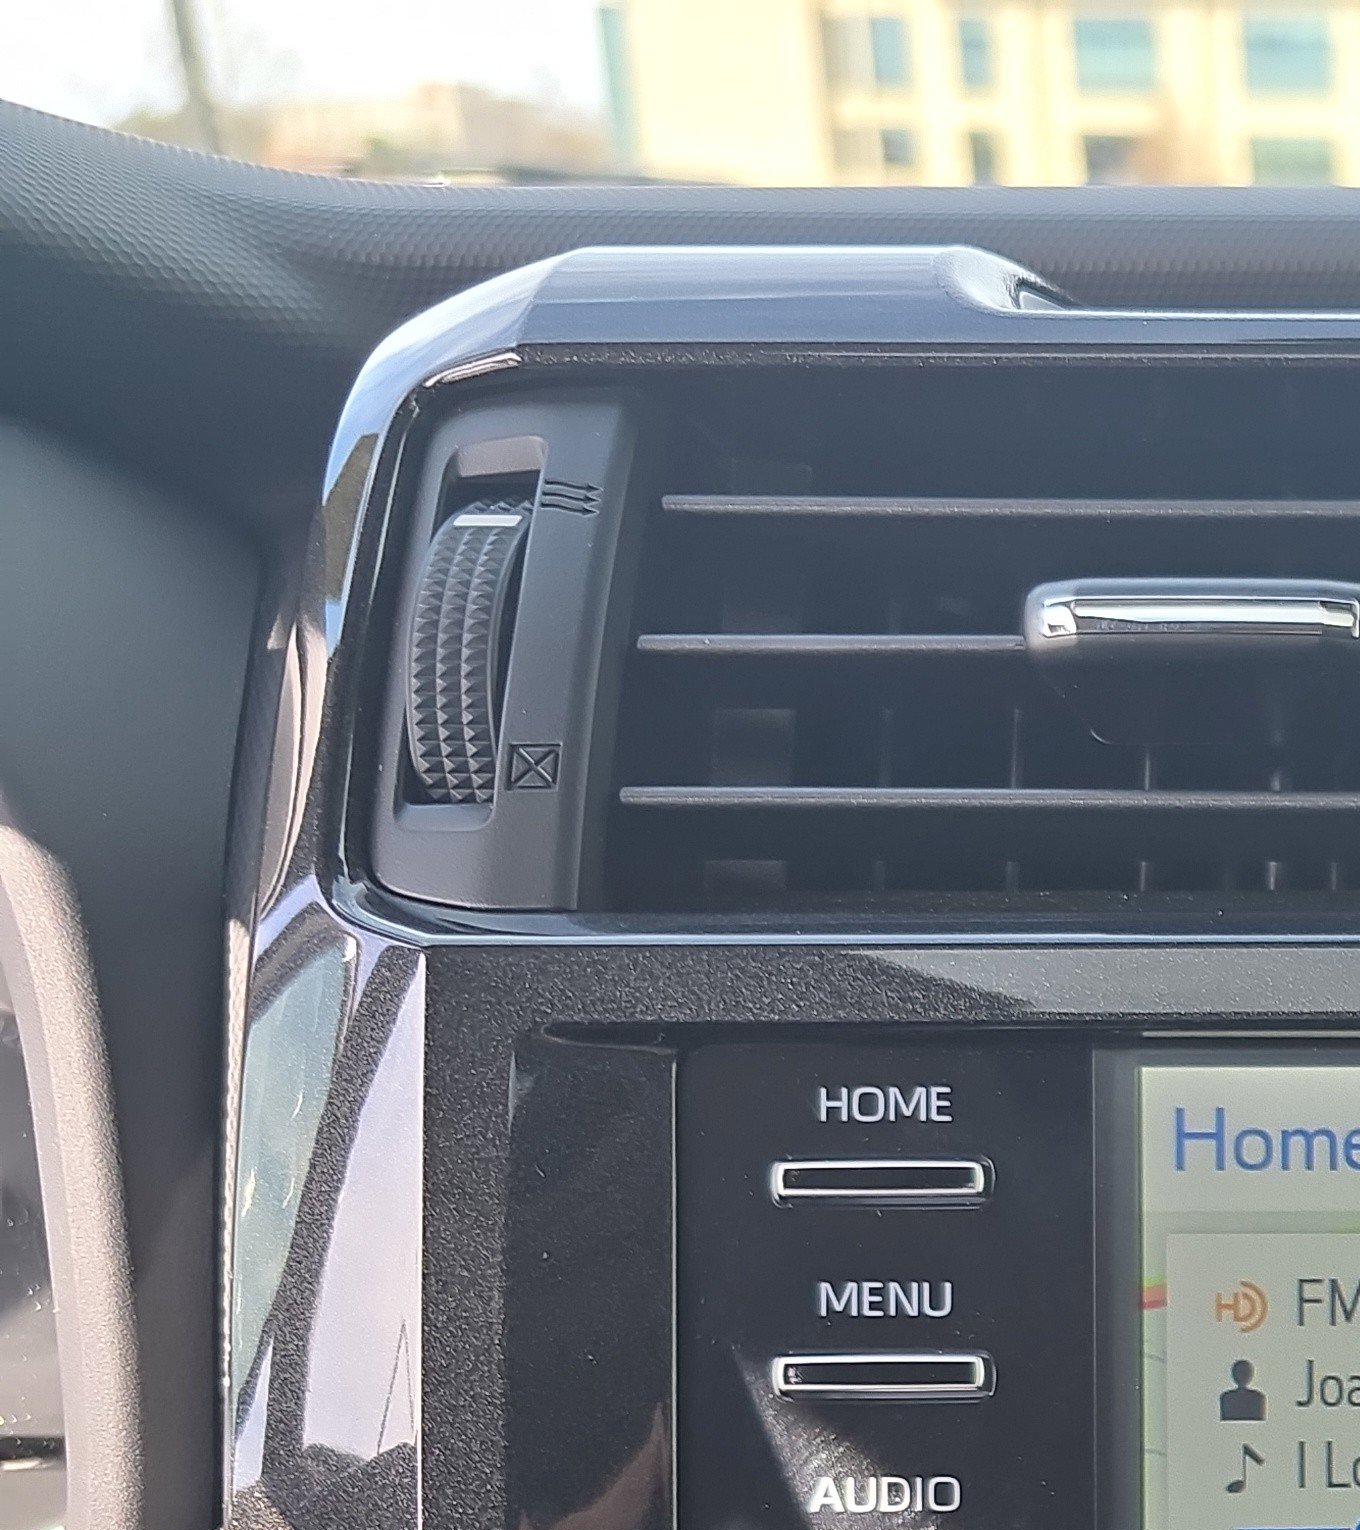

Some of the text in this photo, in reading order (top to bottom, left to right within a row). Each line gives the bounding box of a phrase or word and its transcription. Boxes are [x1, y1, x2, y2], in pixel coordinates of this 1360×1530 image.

[818, 1086, 953, 1123] HOME
[819, 1281, 953, 1317] MENU
[809, 1476, 961, 1513] AUDIO
